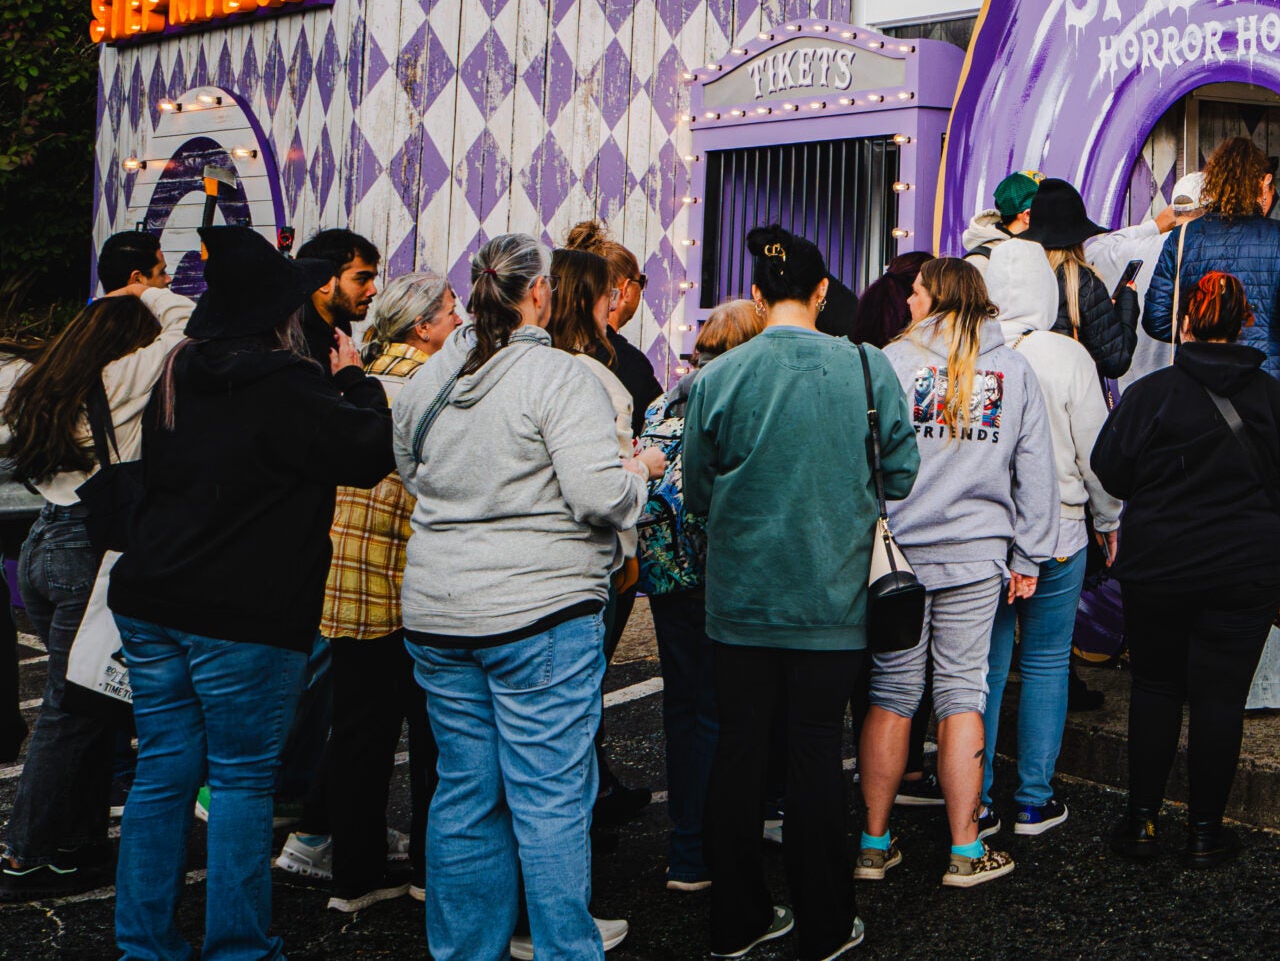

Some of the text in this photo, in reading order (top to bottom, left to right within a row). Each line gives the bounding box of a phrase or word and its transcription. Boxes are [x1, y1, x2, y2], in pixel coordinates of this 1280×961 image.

[747, 46, 856, 99] TIKETS
[1098, 20, 1227, 80] HORROR
[913, 425, 1000, 443] FRIENDS
